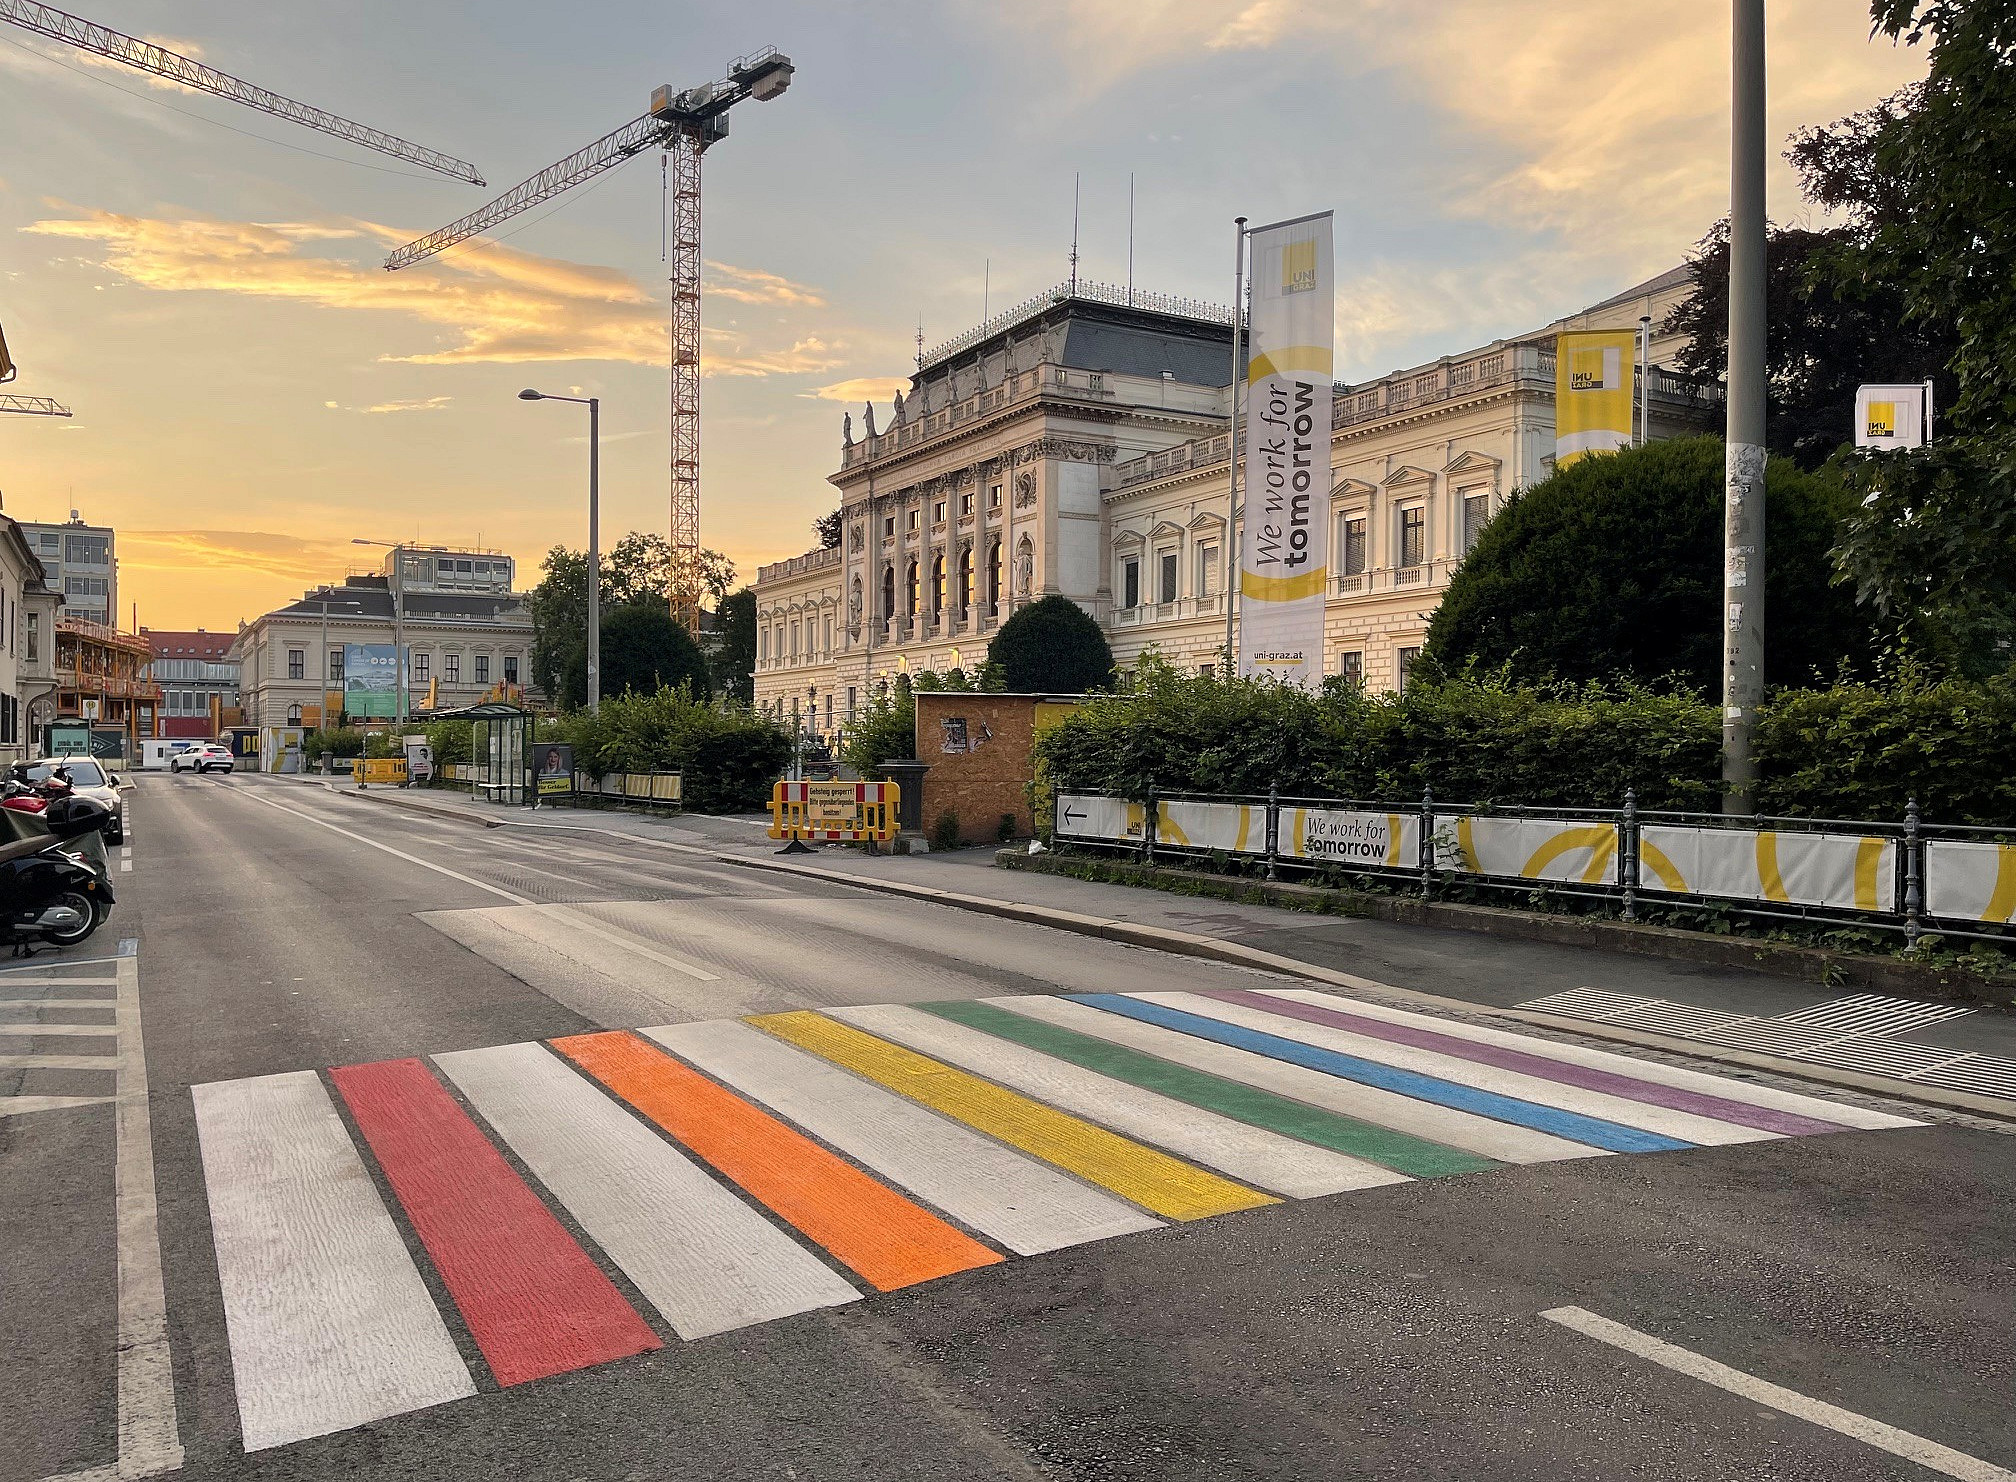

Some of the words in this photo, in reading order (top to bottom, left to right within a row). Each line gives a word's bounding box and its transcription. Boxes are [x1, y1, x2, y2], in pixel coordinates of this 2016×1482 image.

[1293, 269, 1315, 282] UNI
[1293, 281, 1315, 291] GRAZ
[1260, 383, 1290, 432] for
[1259, 438, 1286, 515] work
[1284, 381, 1314, 568] tomorrow
[1256, 524, 1283, 567] We
[1254, 651, 1303, 661] uni-graz.at
[810, 788, 830, 796] Gehsteig
[831, 788, 855, 796] gesperrt!
[1308, 817, 1326, 835] We
[1330, 819, 1361, 837] work
[1364, 820, 1385, 841] for
